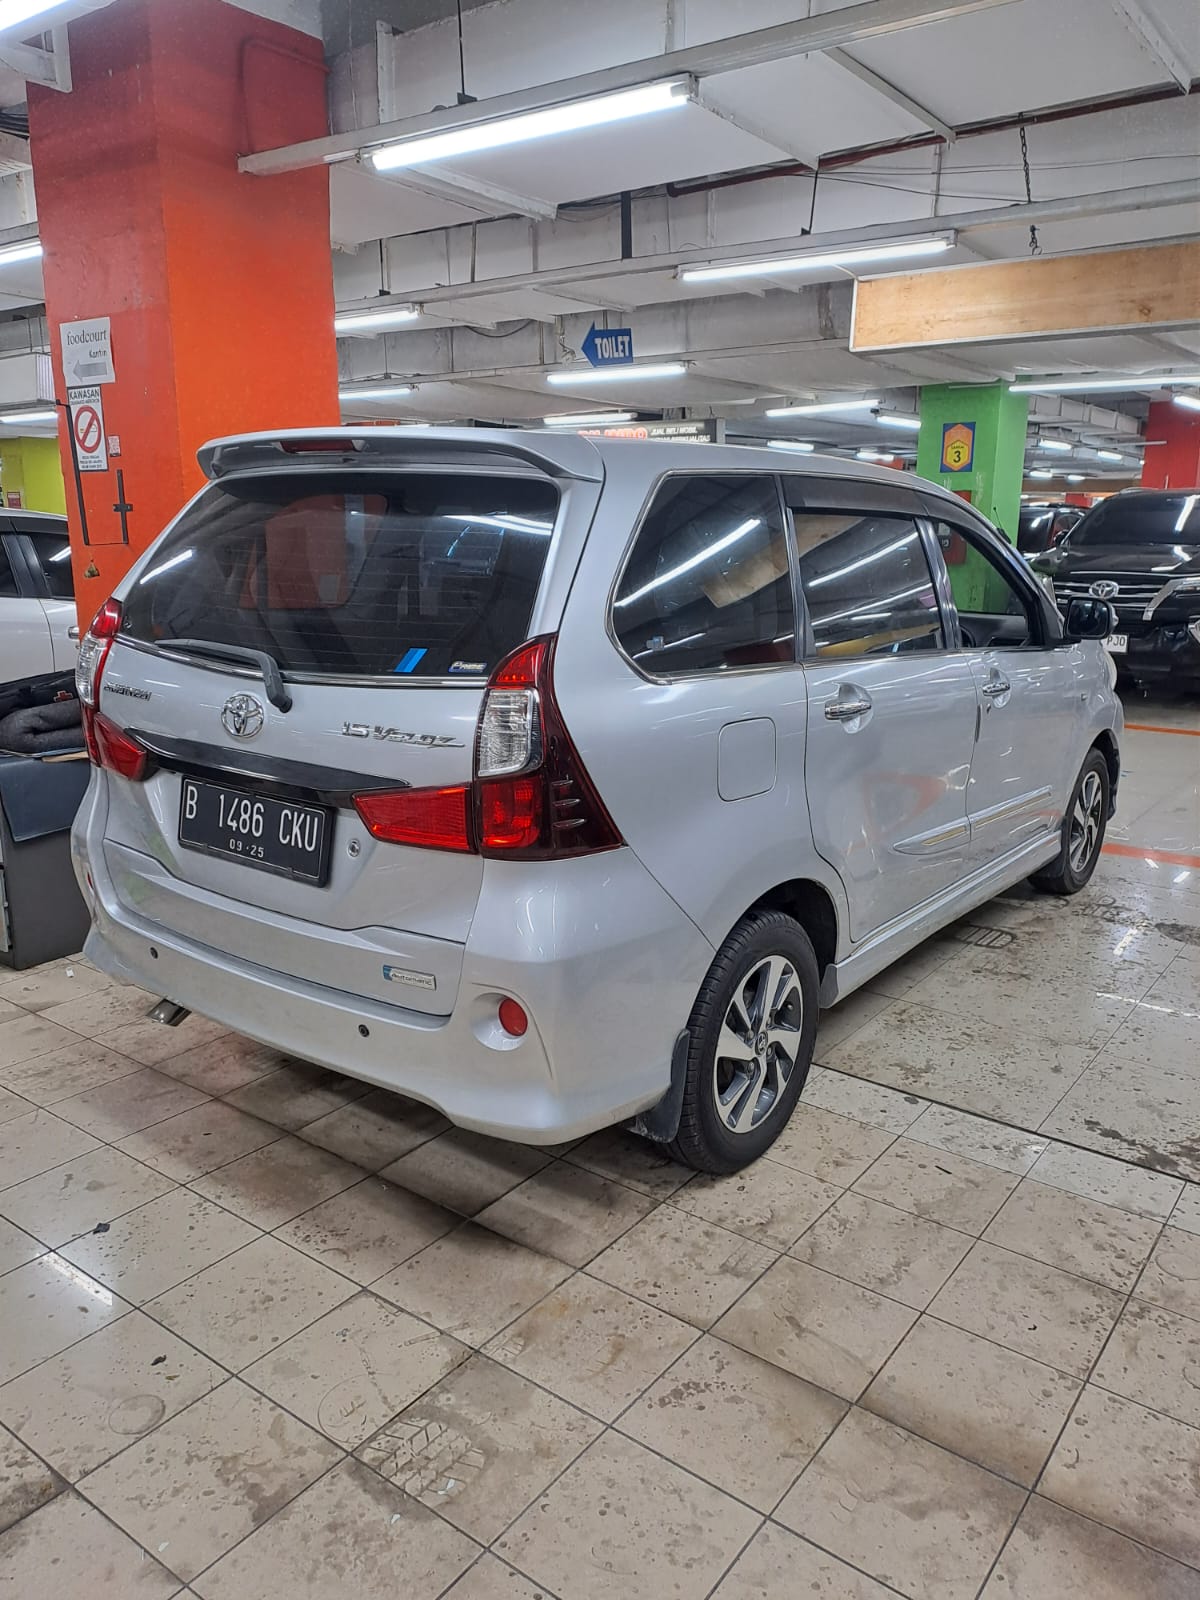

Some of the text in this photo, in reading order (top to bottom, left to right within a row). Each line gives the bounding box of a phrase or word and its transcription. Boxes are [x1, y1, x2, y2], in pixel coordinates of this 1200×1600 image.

[67, 329, 107, 346] foodcourt
[595, 335, 630, 359] TOILET
[69, 388, 99, 400] KAWASAN
[953, 450, 961, 463] 3
[186, 785, 318, 851] B 1486 CKU
